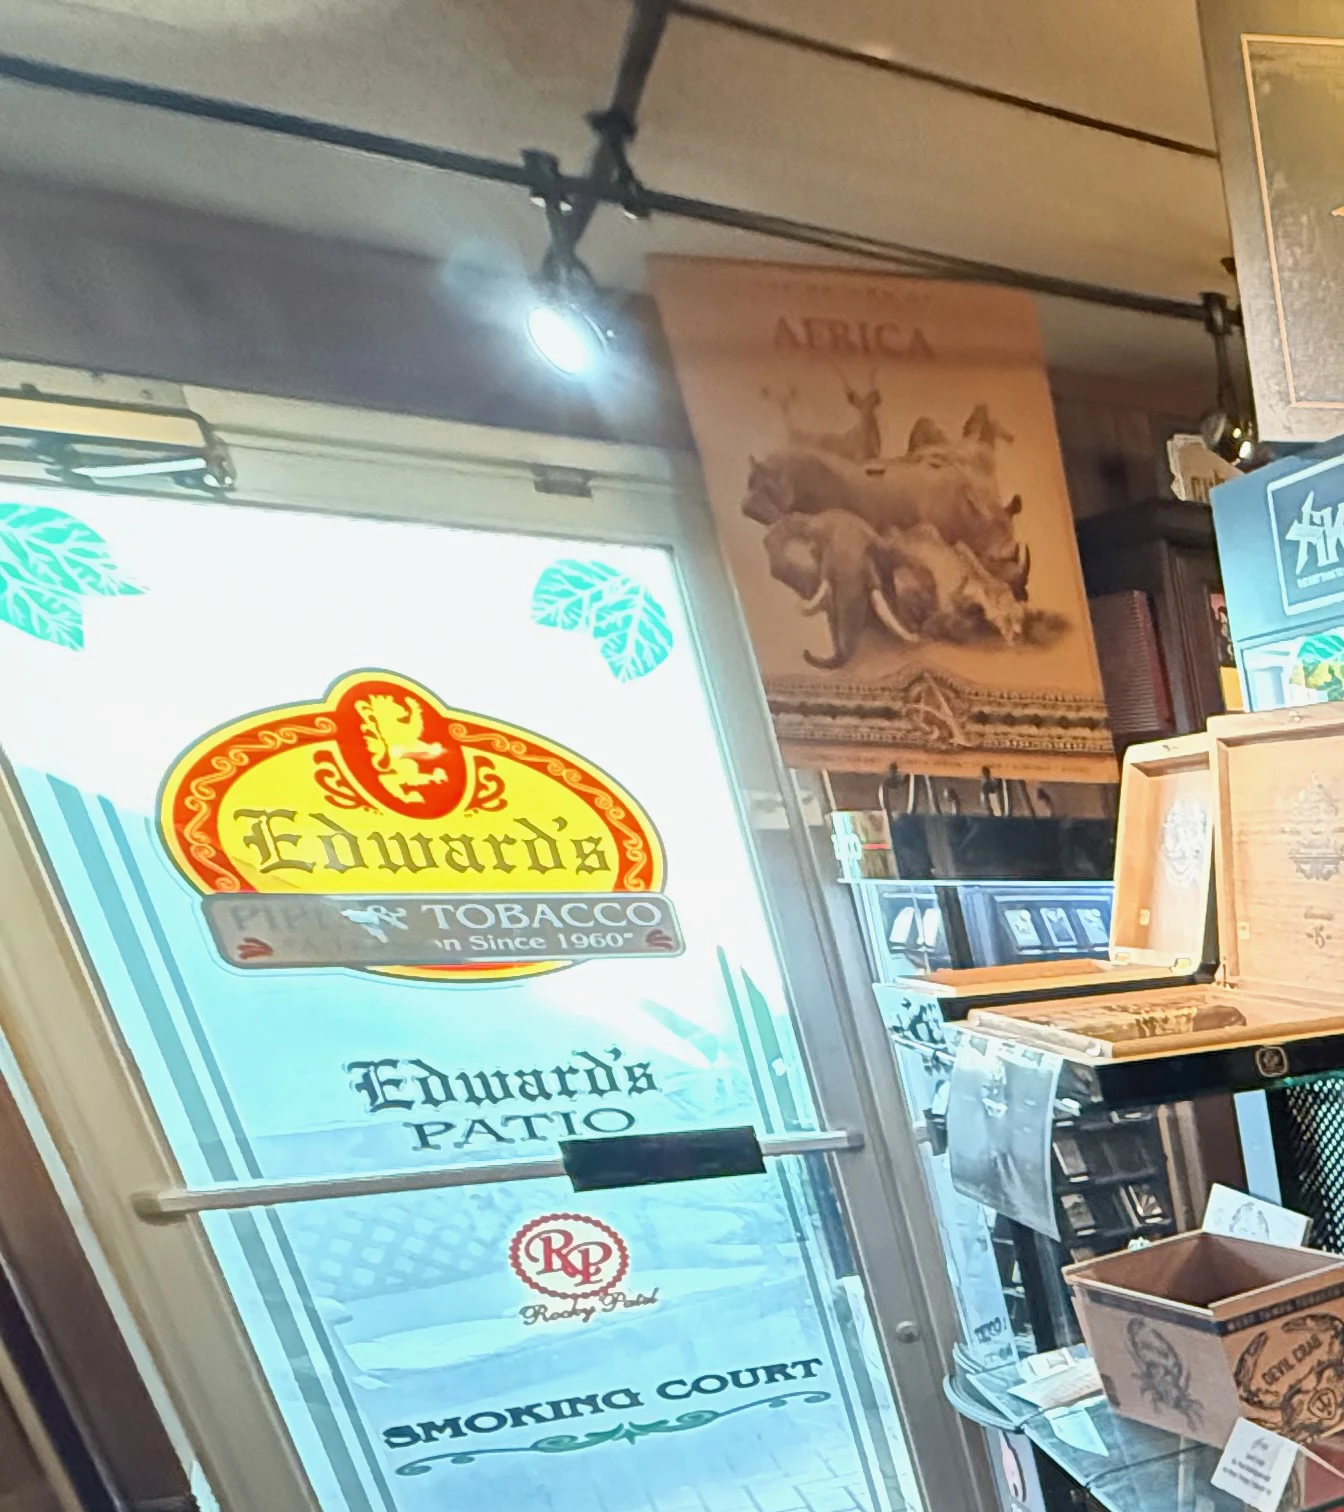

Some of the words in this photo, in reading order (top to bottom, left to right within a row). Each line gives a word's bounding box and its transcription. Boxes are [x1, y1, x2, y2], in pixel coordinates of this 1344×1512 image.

[774, 316, 936, 359] AFRICA
[234, 809, 612, 875] Edward's
[422, 903, 662, 930] TOBACCO
[471, 934, 546, 951] Since
[347, 1048, 661, 1113] Edward's
[403, 1108, 636, 1150] PATIO
[524, 1229, 613, 1287] RP
[1262, 1357, 1295, 1386] DEVIL
[1292, 1334, 1322, 1362] CRAB
[383, 1388, 645, 1450] SMOKING
[656, 1358, 822, 1401] COURT
